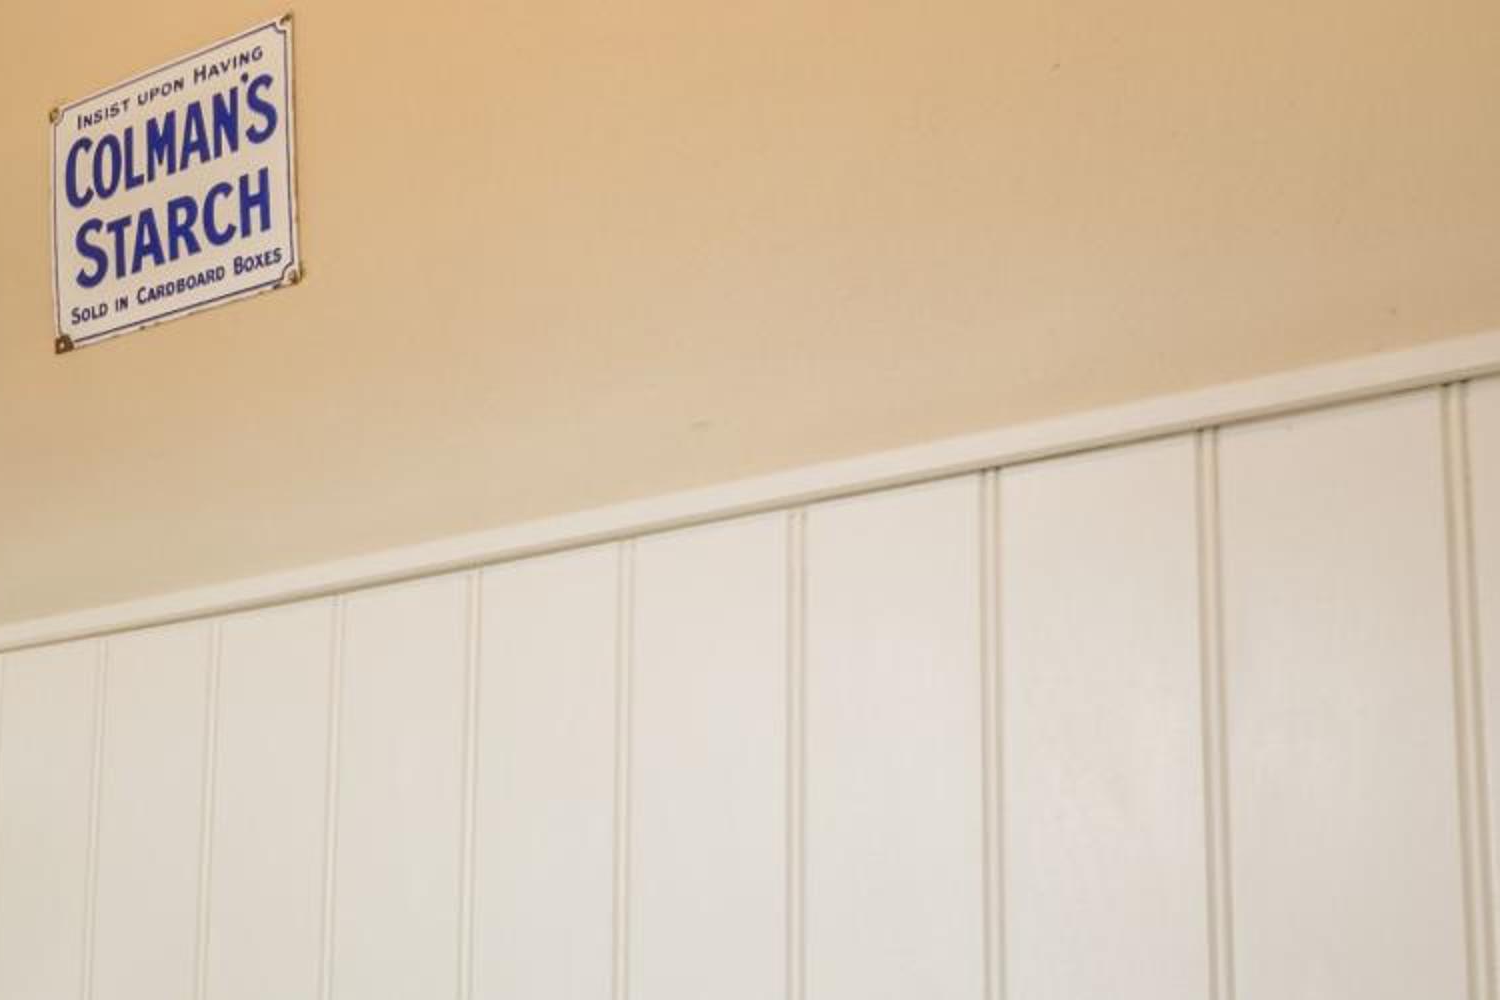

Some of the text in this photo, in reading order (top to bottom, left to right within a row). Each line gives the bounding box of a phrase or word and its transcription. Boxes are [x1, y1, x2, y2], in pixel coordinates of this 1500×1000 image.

[77, 46, 264, 131] INSIST UPON HAVING
[65, 72, 277, 209] COLMAN'S
[75, 167, 271, 289] STARCH
[71, 248, 283, 326] SOLD IN CARDBOARD BOXES
